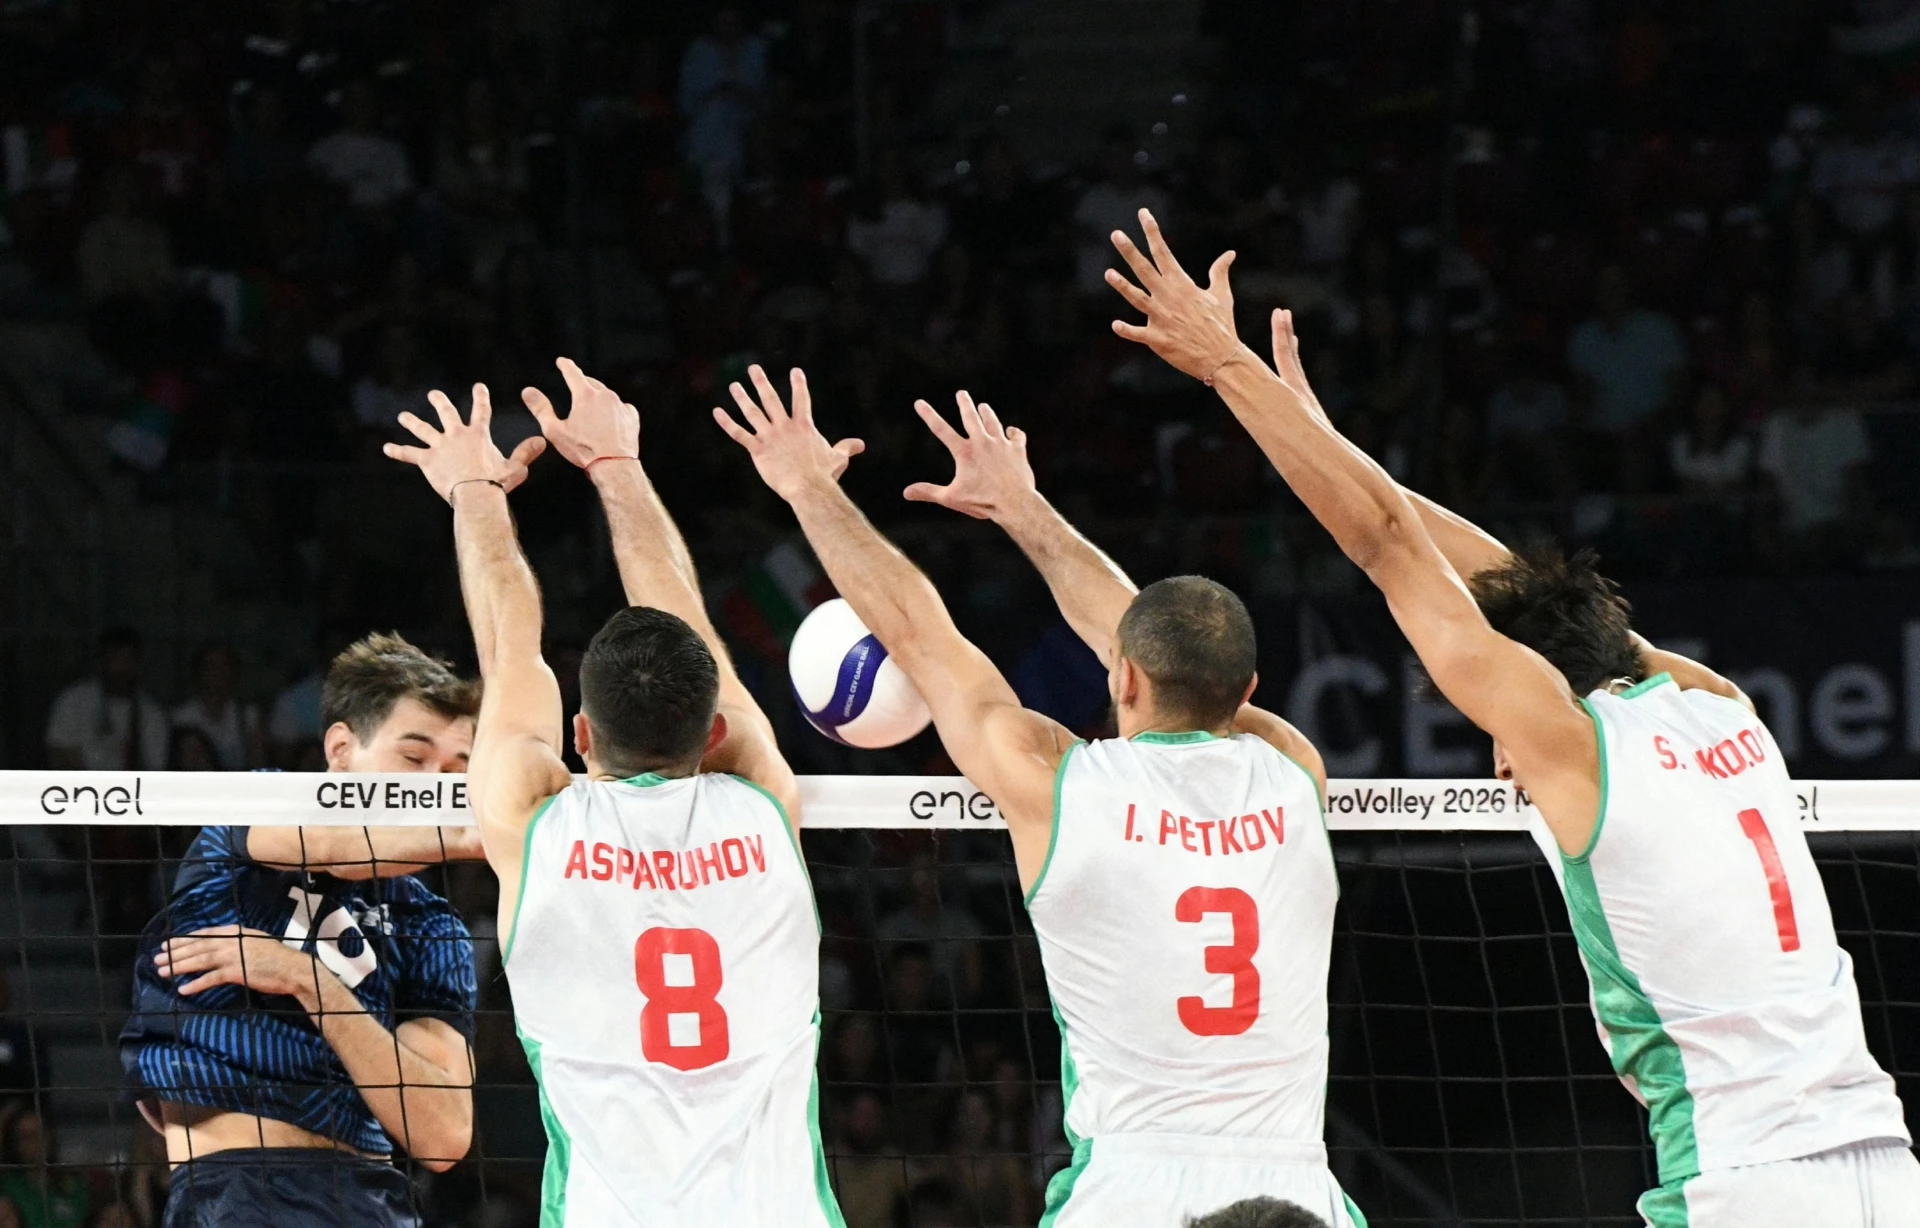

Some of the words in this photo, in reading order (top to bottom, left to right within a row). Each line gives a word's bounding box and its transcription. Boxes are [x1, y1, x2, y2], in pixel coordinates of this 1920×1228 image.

[854, 661, 864, 680] GAME
[1655, 616, 1920, 760] nel
[41, 777, 143, 816] enel
[316, 782, 377, 809] CEV
[385, 781, 442, 809] Enel
[452, 783, 472, 809] E
[909, 791, 1005, 820] ene
[1323, 787, 1434, 820] roVolley
[1443, 788, 1506, 814] 2026
[1125, 803, 1144, 842] I.
[1159, 806, 1284, 856] PETKOV
[564, 834, 766, 890] ASPARUHOV
[1737, 808, 1801, 953] 1
[1175, 886, 1260, 1037] 3
[634, 926, 730, 1072] 8
